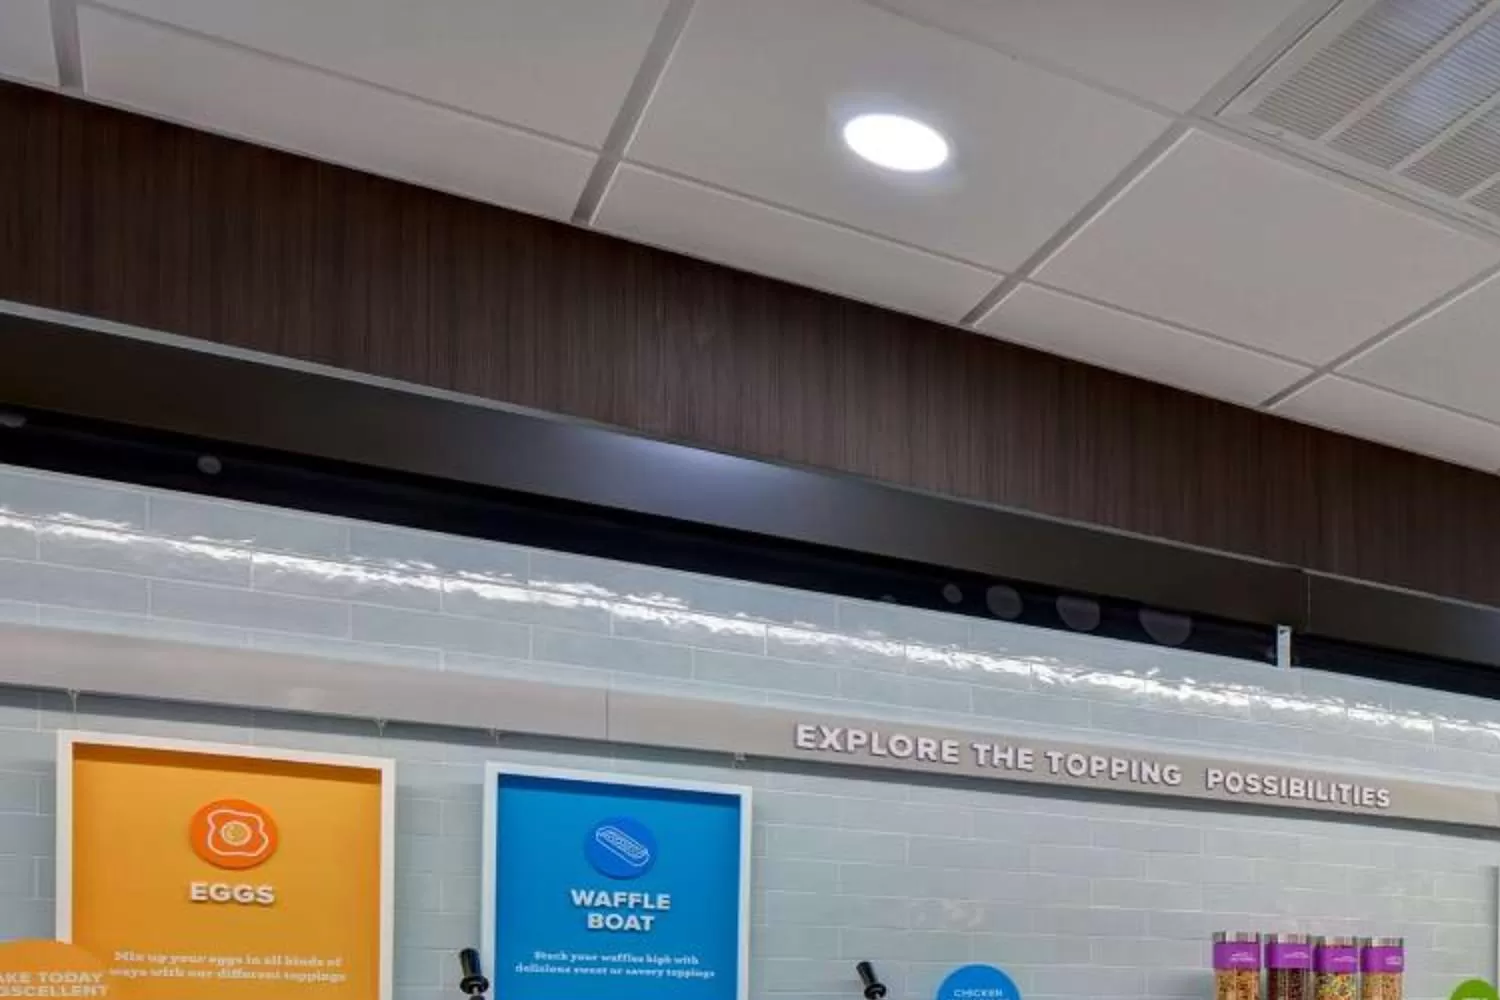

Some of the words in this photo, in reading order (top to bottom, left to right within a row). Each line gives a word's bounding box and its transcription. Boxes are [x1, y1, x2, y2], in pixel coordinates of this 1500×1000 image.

[796, 723, 960, 764] EXPLORE
[971, 742, 1033, 770] THE
[1045, 751, 1182, 786] TOPPING
[1206, 768, 1390, 807] POSSIBILITIES
[191, 881, 275, 905] EGGS
[570, 888, 671, 910] WAFFLE
[587, 913, 655, 931] BOAT
[37, 971, 104, 985] TODAY
[953, 988, 1003, 997] CHICKEN
